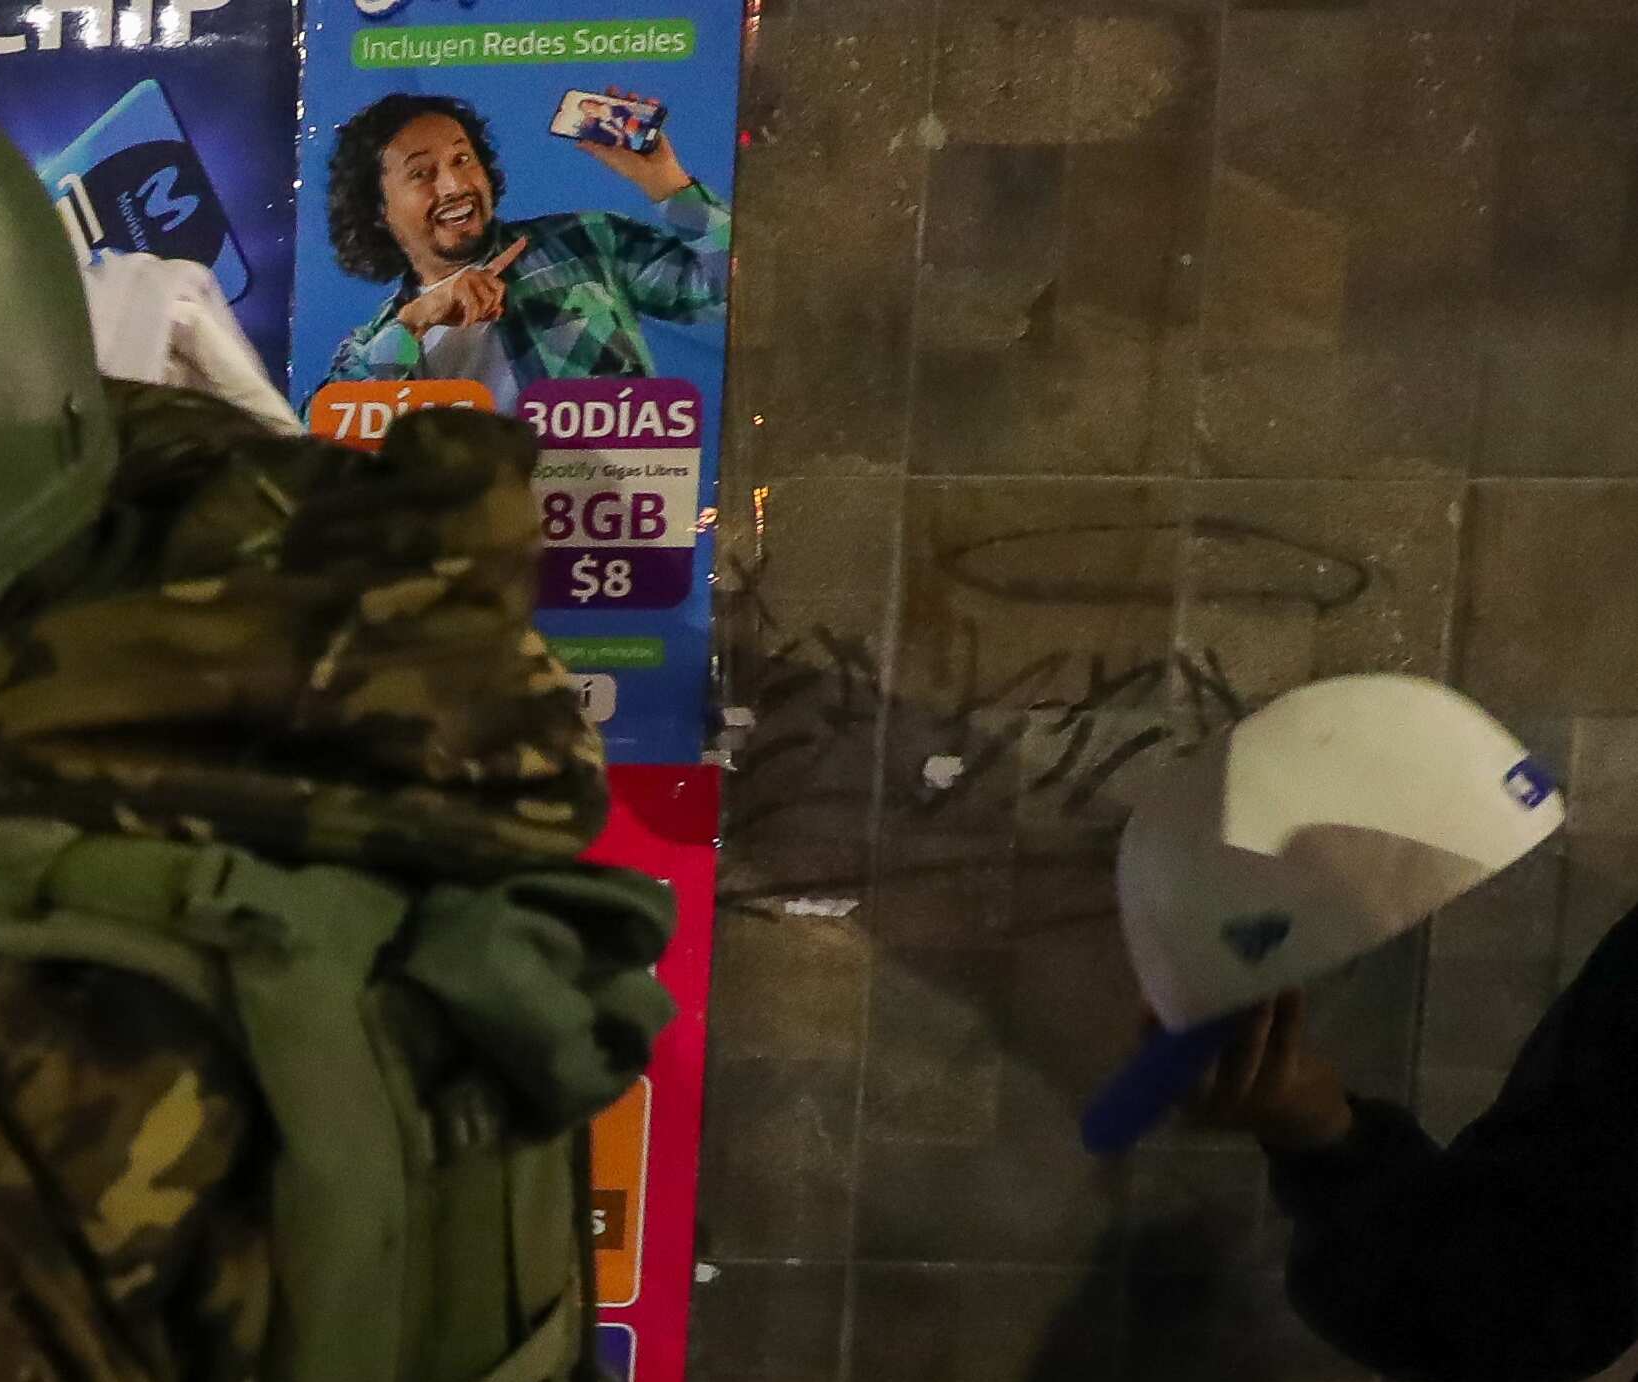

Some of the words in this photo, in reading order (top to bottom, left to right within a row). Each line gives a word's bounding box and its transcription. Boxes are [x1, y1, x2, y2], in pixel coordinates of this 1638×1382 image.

[362, 33, 475, 66] Incluyen
[483, 30, 566, 56] Redes
[573, 26, 686, 54] Sociales
[524, 386, 696, 438] 30DÍAS
[602, 464, 642, 480] Gigas
[645, 463, 689, 477] Libres
[542, 492, 667, 541] 8GB
[570, 554, 632, 603] $8
